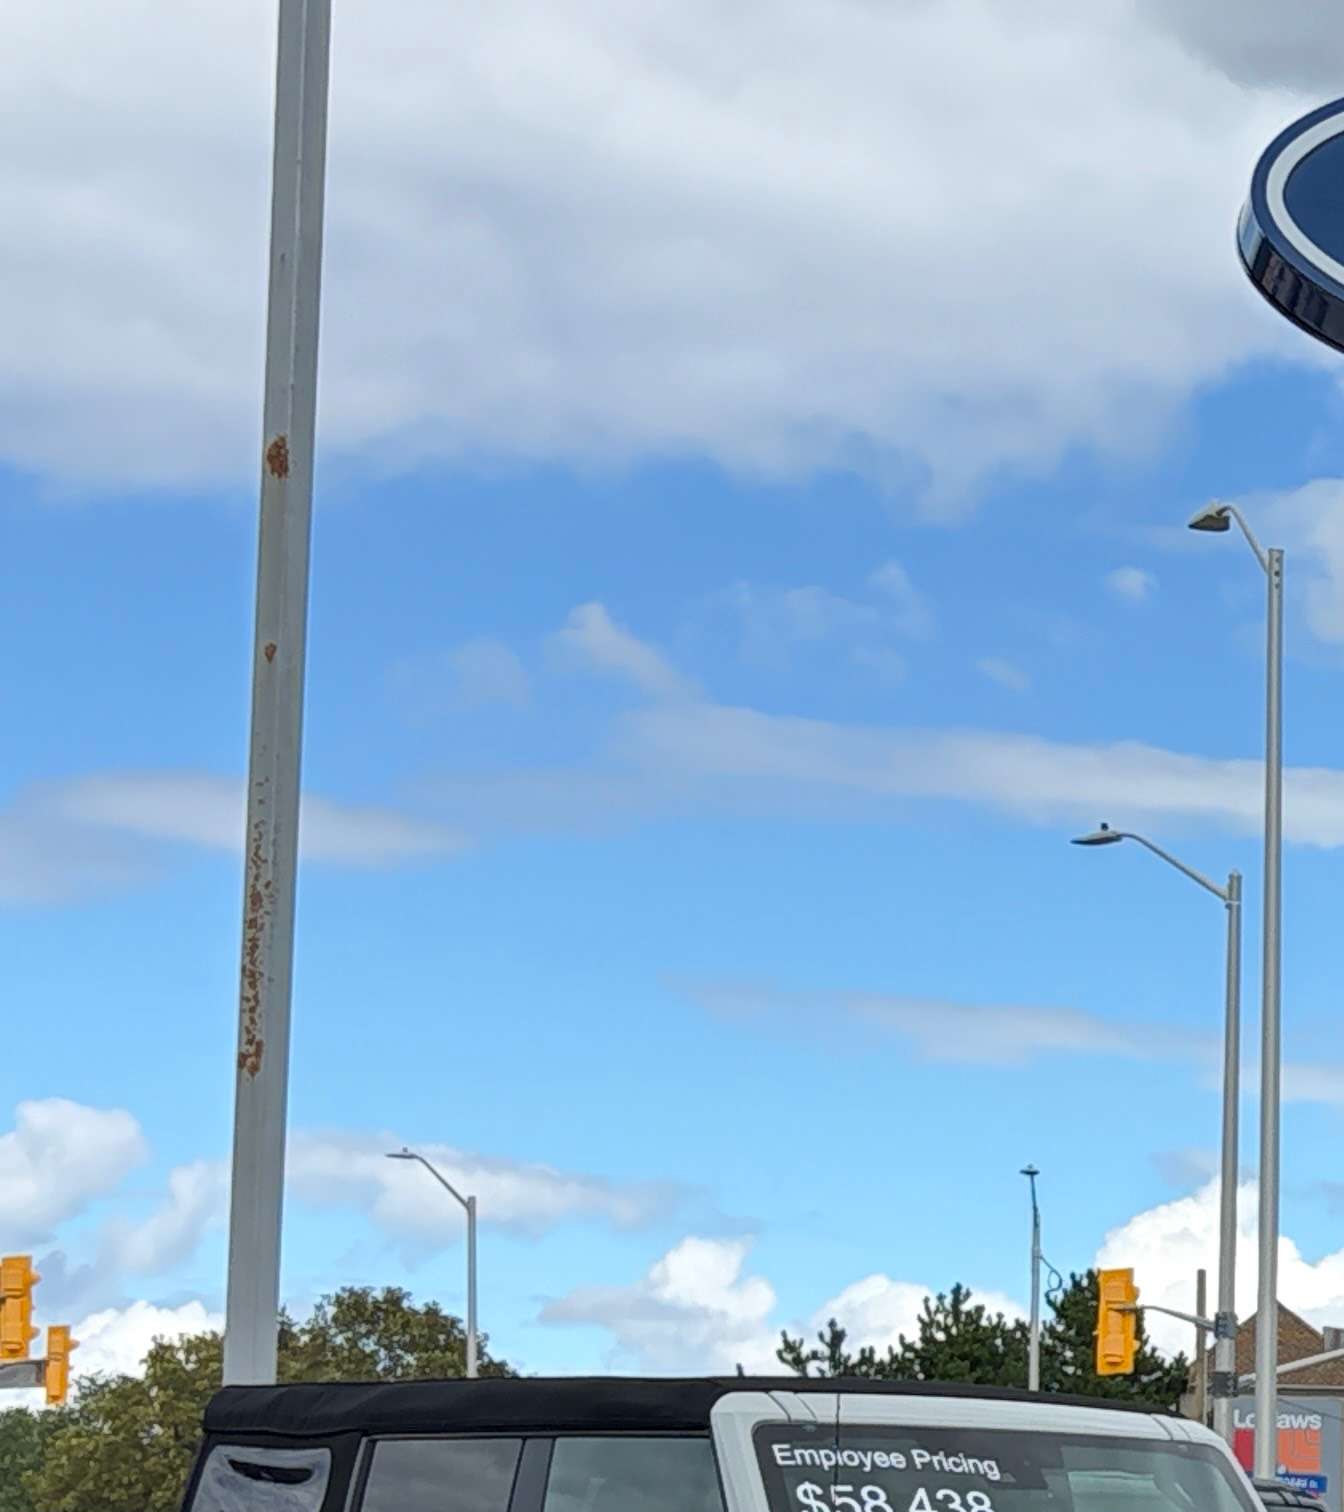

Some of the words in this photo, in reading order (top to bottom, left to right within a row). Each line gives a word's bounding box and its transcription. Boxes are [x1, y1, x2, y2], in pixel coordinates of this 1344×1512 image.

[1233, 1408, 1323, 1430] Loaws
[771, 1443, 907, 1473] Employee
[910, 1449, 1001, 1481] Pricing
